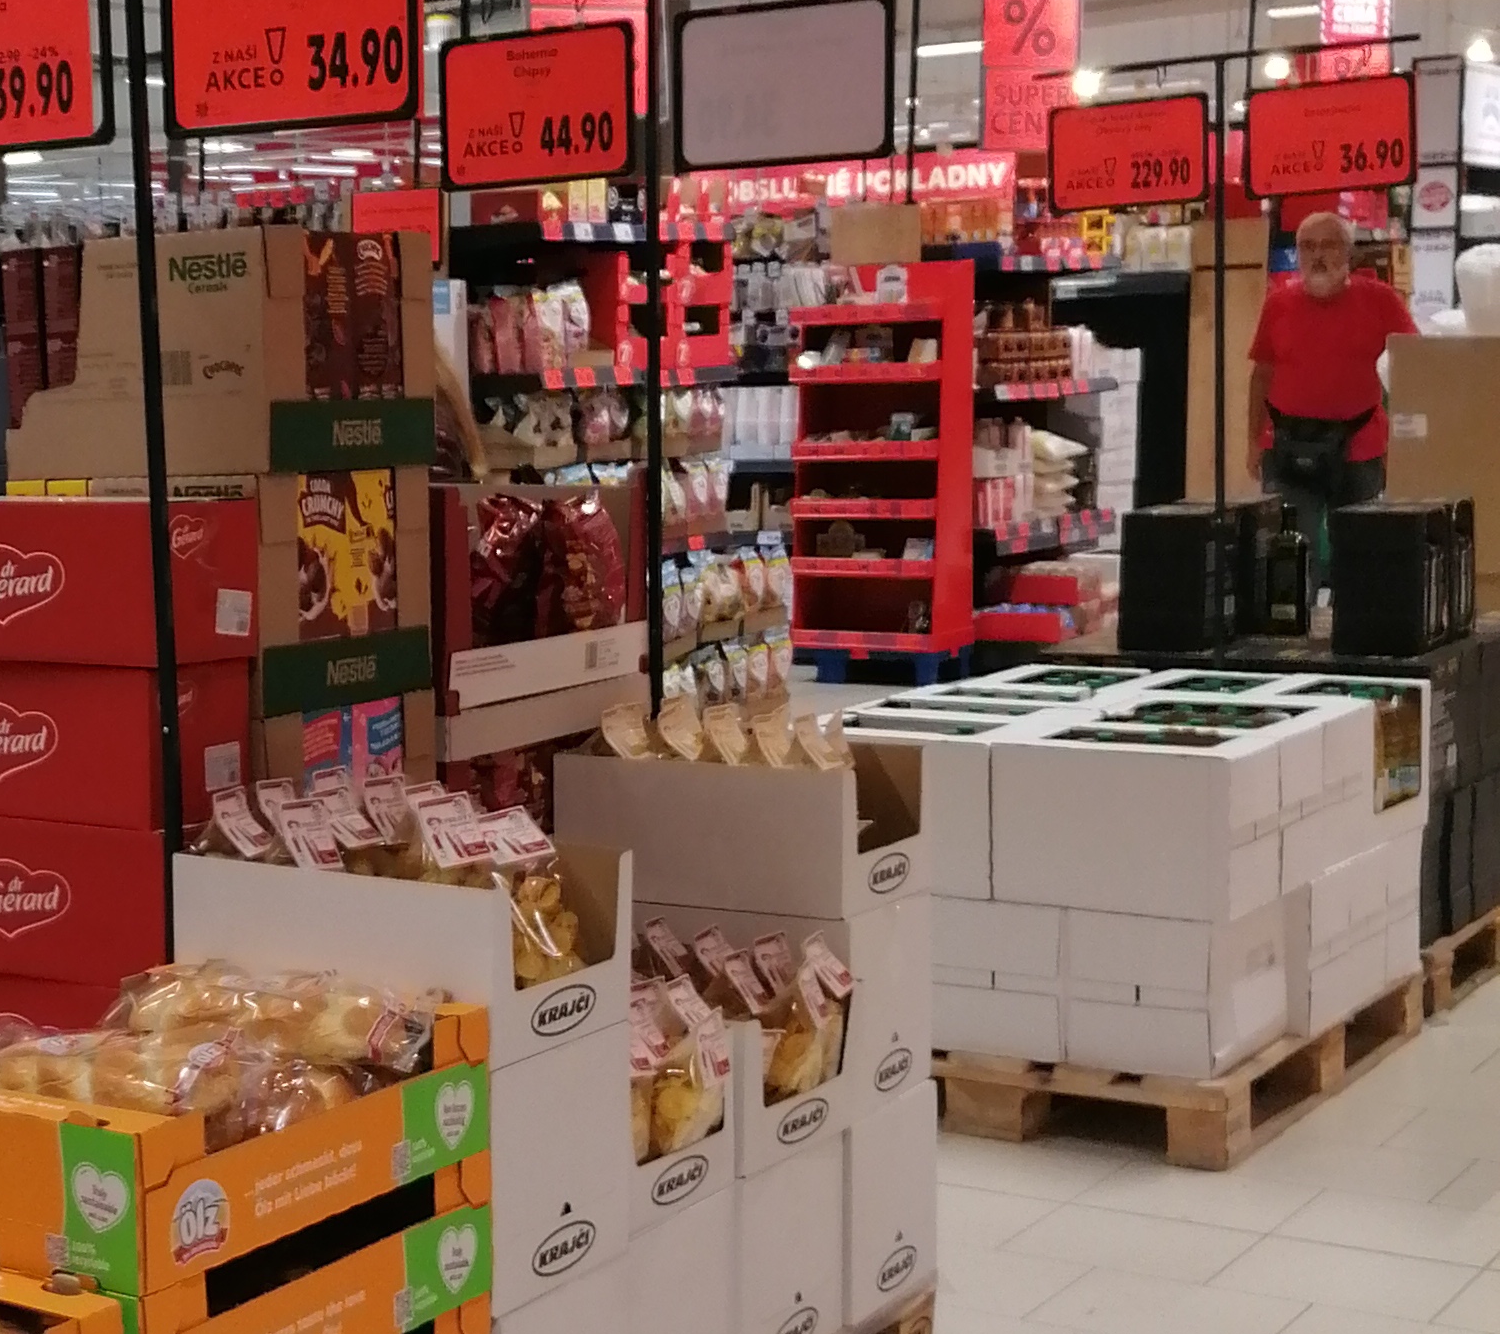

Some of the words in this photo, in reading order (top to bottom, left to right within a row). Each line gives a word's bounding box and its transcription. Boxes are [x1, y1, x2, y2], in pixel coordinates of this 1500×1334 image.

[307, 25, 403, 92] 34.90
[205, 67, 266, 93] AKCE
[463, 140, 510, 159] AKCE
[540, 110, 614, 157] 44.90
[1130, 156, 1191, 190] 229.90
[1339, 138, 1405, 174] 36.90
[0, 558, 18, 579] dr
[536, 1225, 594, 1270] KRAJČI
